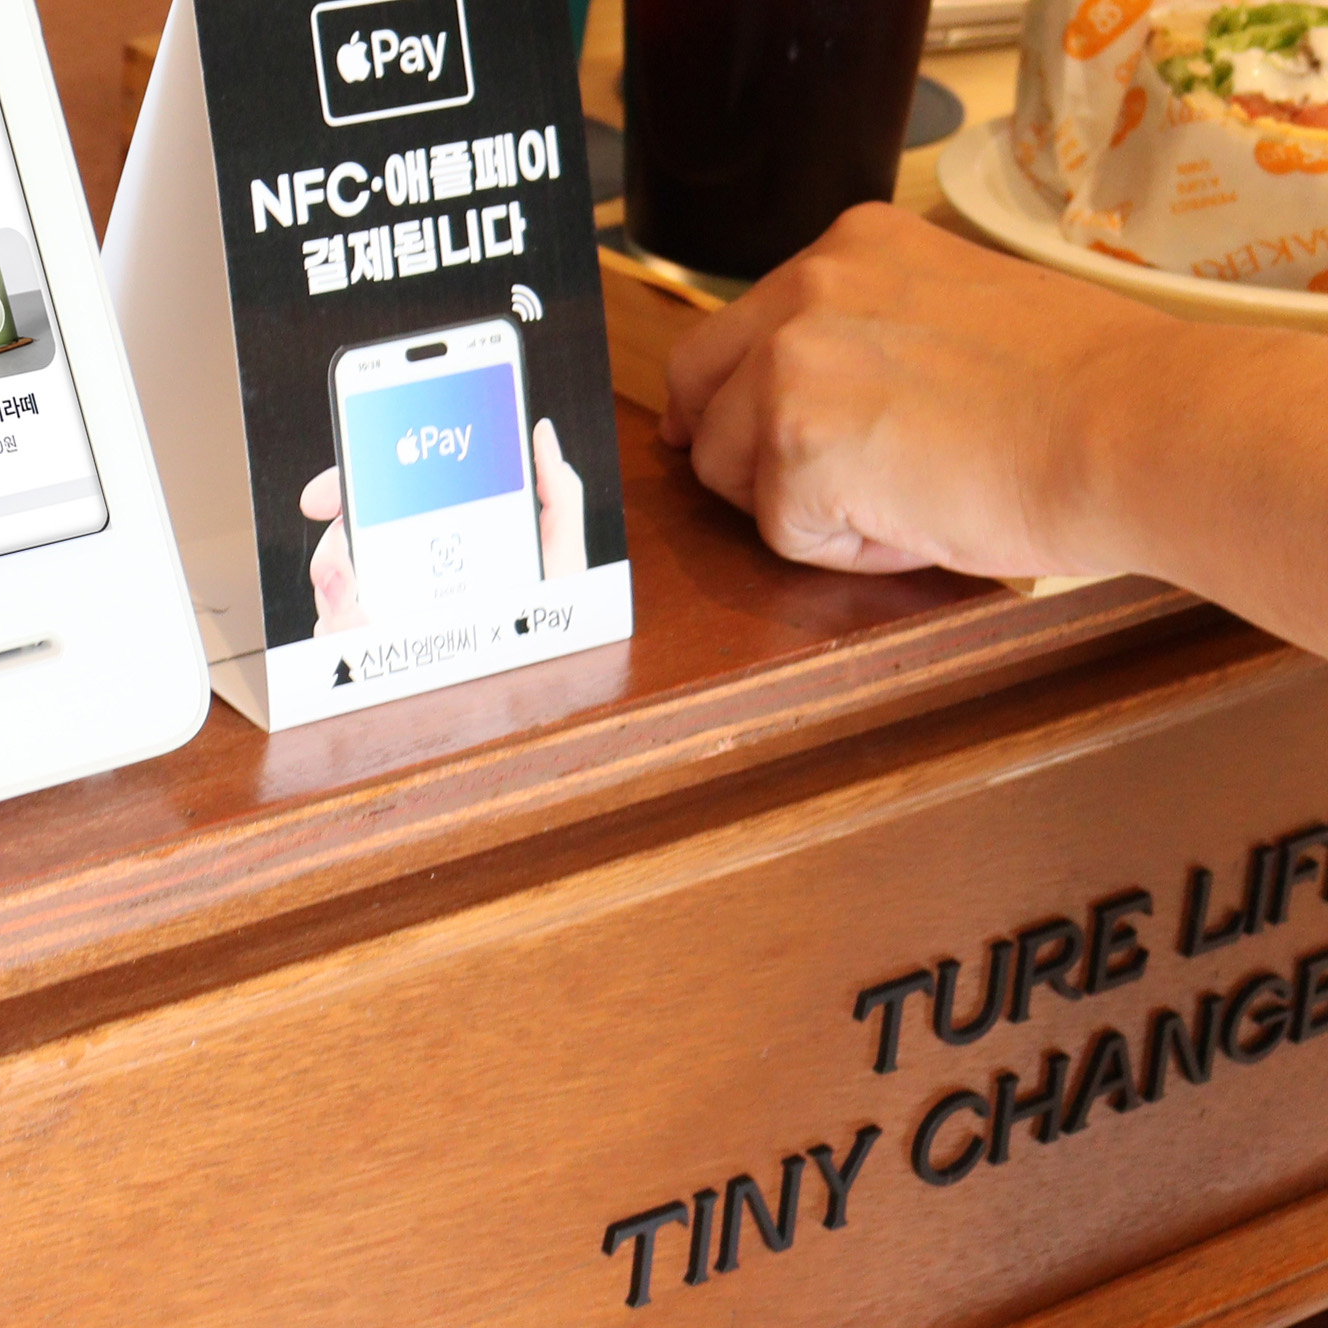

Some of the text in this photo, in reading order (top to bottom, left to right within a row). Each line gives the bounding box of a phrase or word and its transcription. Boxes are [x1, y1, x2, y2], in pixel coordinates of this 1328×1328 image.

[371, 28, 448, 83] Pay
[301, 200, 527, 297] 결제됩니다
[419, 423, 473, 462] Pay
[360, 623, 478, 681] 신신엠앤씨
[532, 604, 574, 634] Pay
[852, 820, 1328, 1075] TURE LIF
[601, 1124, 884, 1309] TINY
